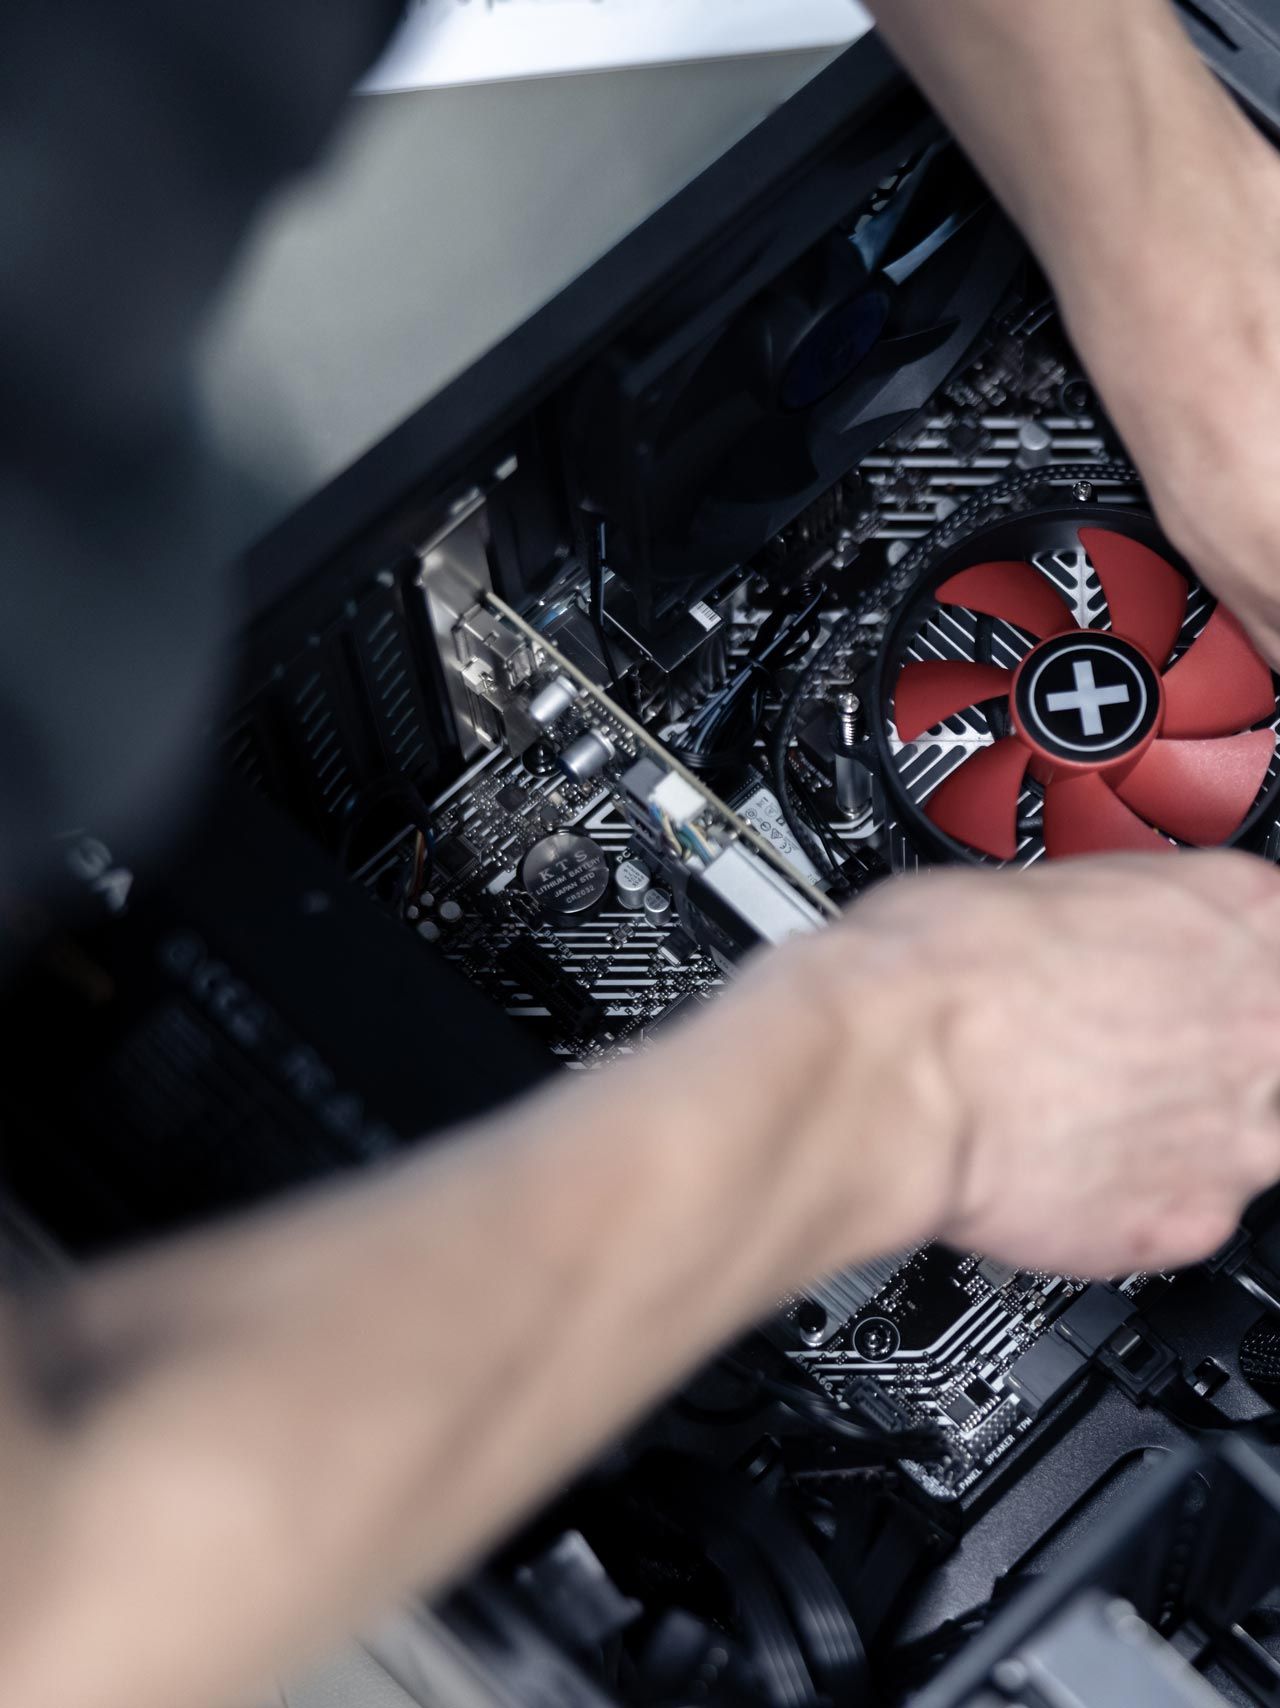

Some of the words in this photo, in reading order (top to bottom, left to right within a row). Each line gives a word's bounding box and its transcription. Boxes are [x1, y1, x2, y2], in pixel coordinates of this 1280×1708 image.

[536, 875, 567, 895] LITHIUM
[568, 857, 601, 878] BATTERY
[555, 881, 578, 898] JAPAN
[580, 872, 595, 884] STD
[566, 885, 595, 904] CR2032
[544, 930, 573, 958] BATTERY
[984, 1434, 1016, 1466] SPEAKER
[1017, 1416, 1033, 1432] TPM
